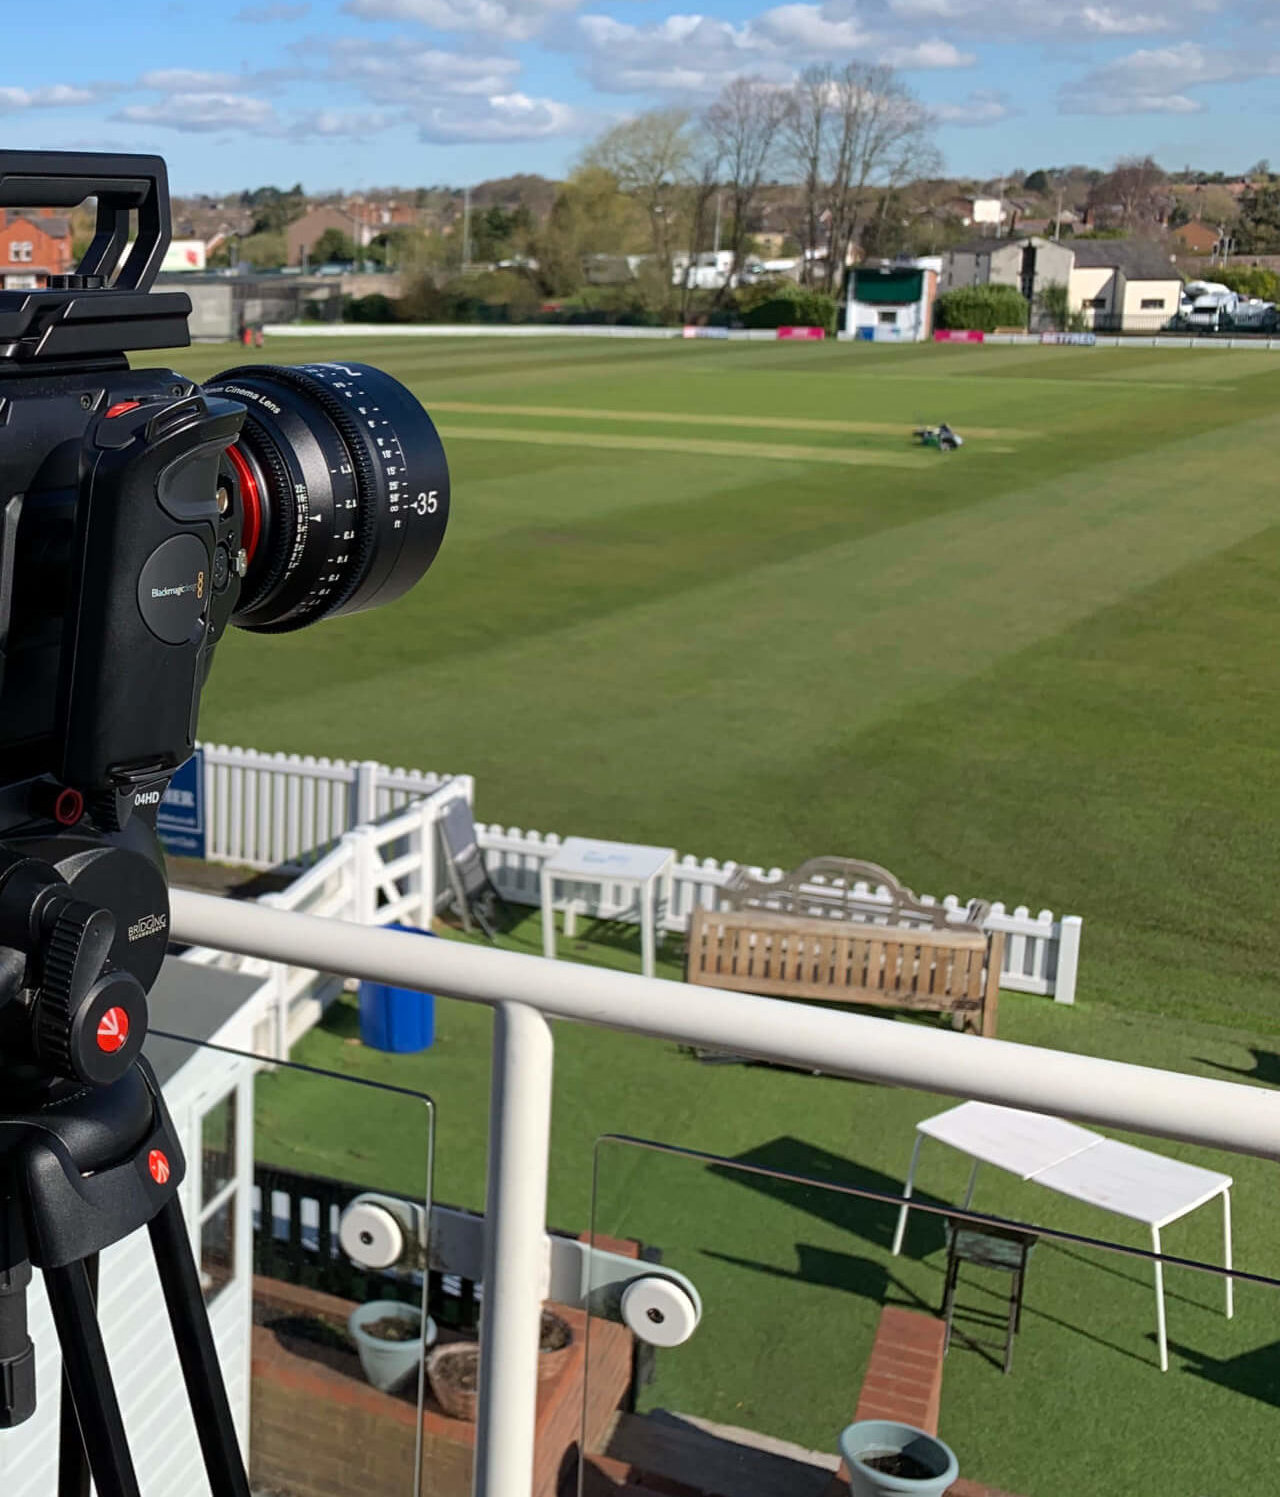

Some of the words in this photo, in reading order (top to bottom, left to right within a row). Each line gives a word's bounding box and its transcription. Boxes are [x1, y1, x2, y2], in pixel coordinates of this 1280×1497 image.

[225, 385, 260, 400] Cinema
[258, 395, 281, 414] Lens
[417, 490, 438, 516] 35
[134, 791, 160, 806] 04HD
[128, 913, 166, 936] BRIDGING
